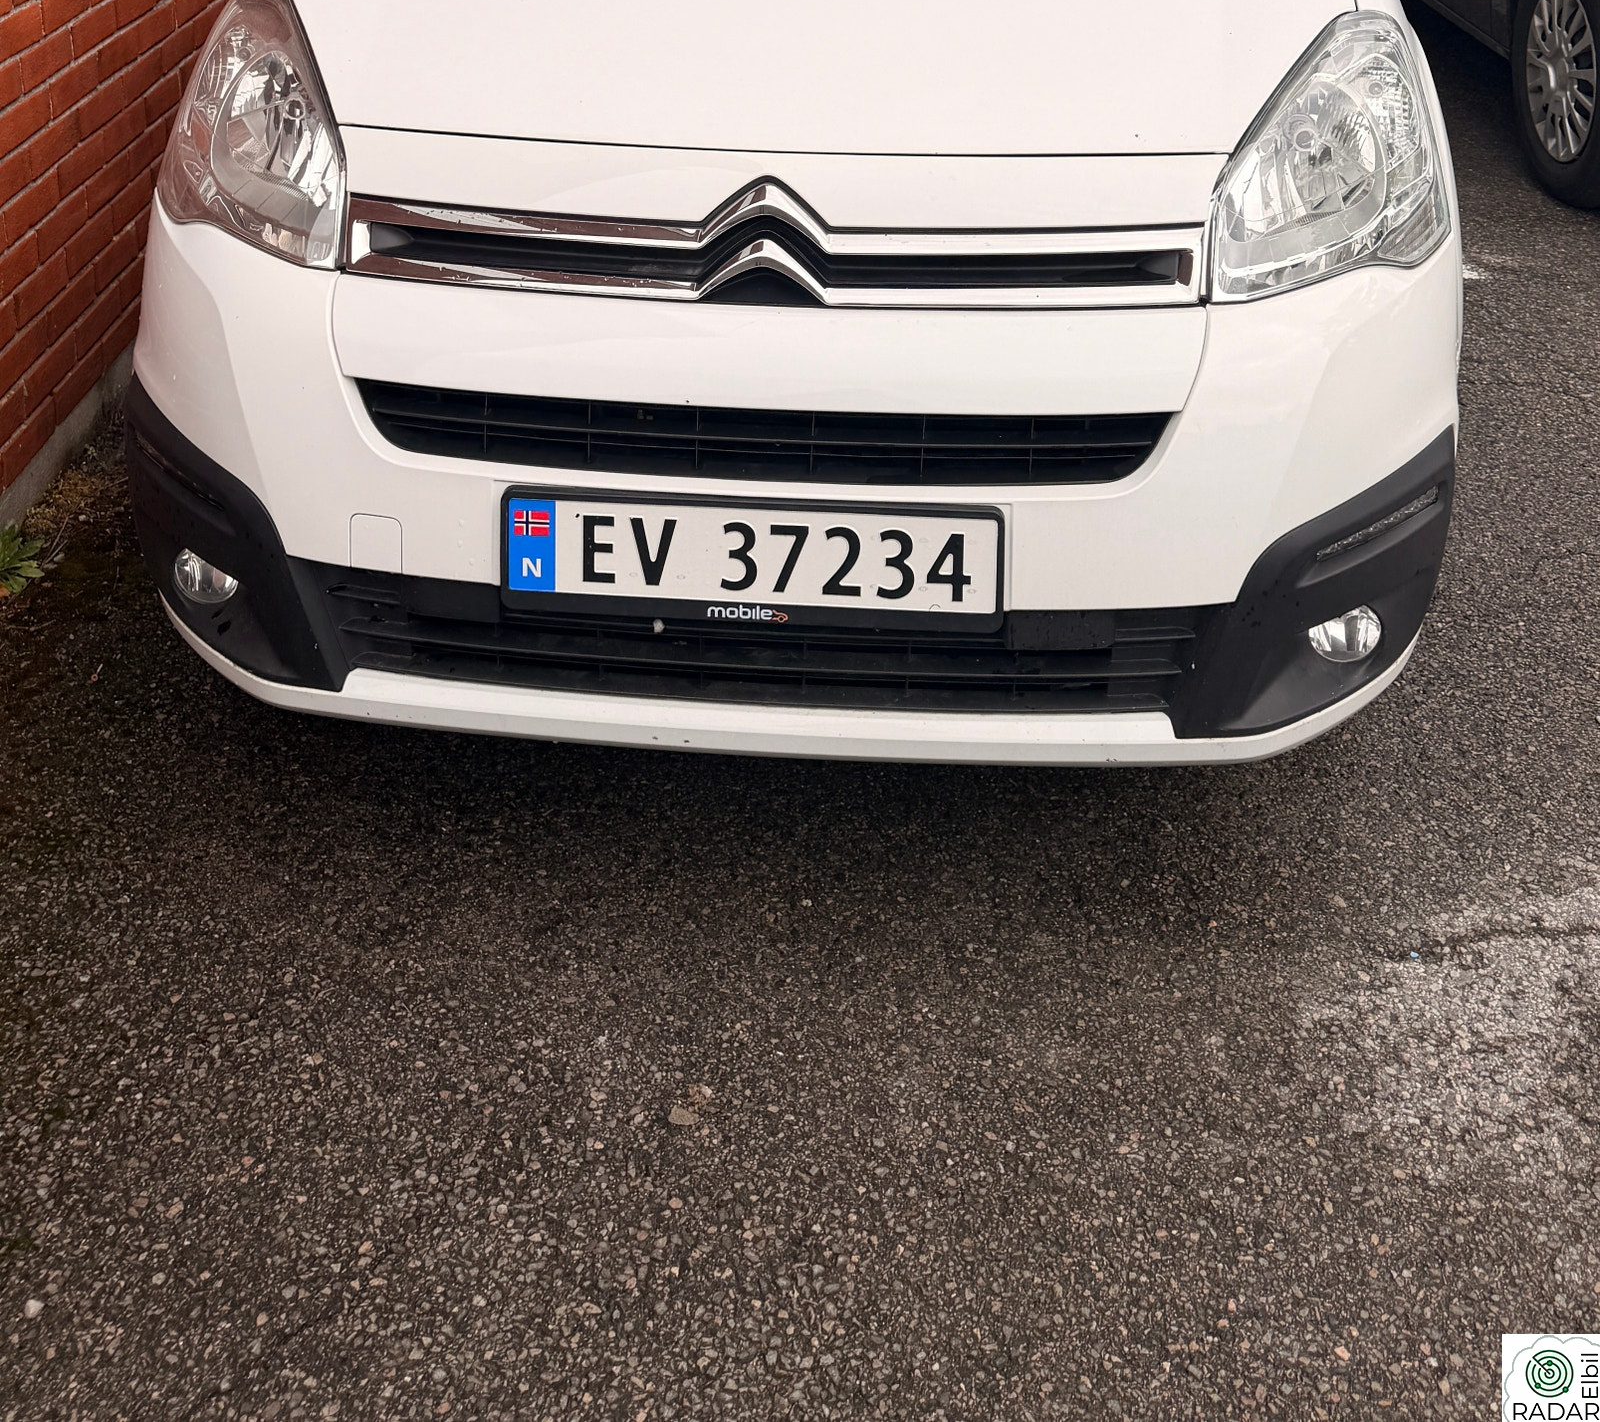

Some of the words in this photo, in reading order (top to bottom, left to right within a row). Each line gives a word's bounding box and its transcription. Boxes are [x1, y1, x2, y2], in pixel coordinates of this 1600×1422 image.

[521, 557, 542, 578] N
[582, 514, 677, 587] EV
[719, 521, 972, 602] 37234
[707, 604, 773, 621] mobile
